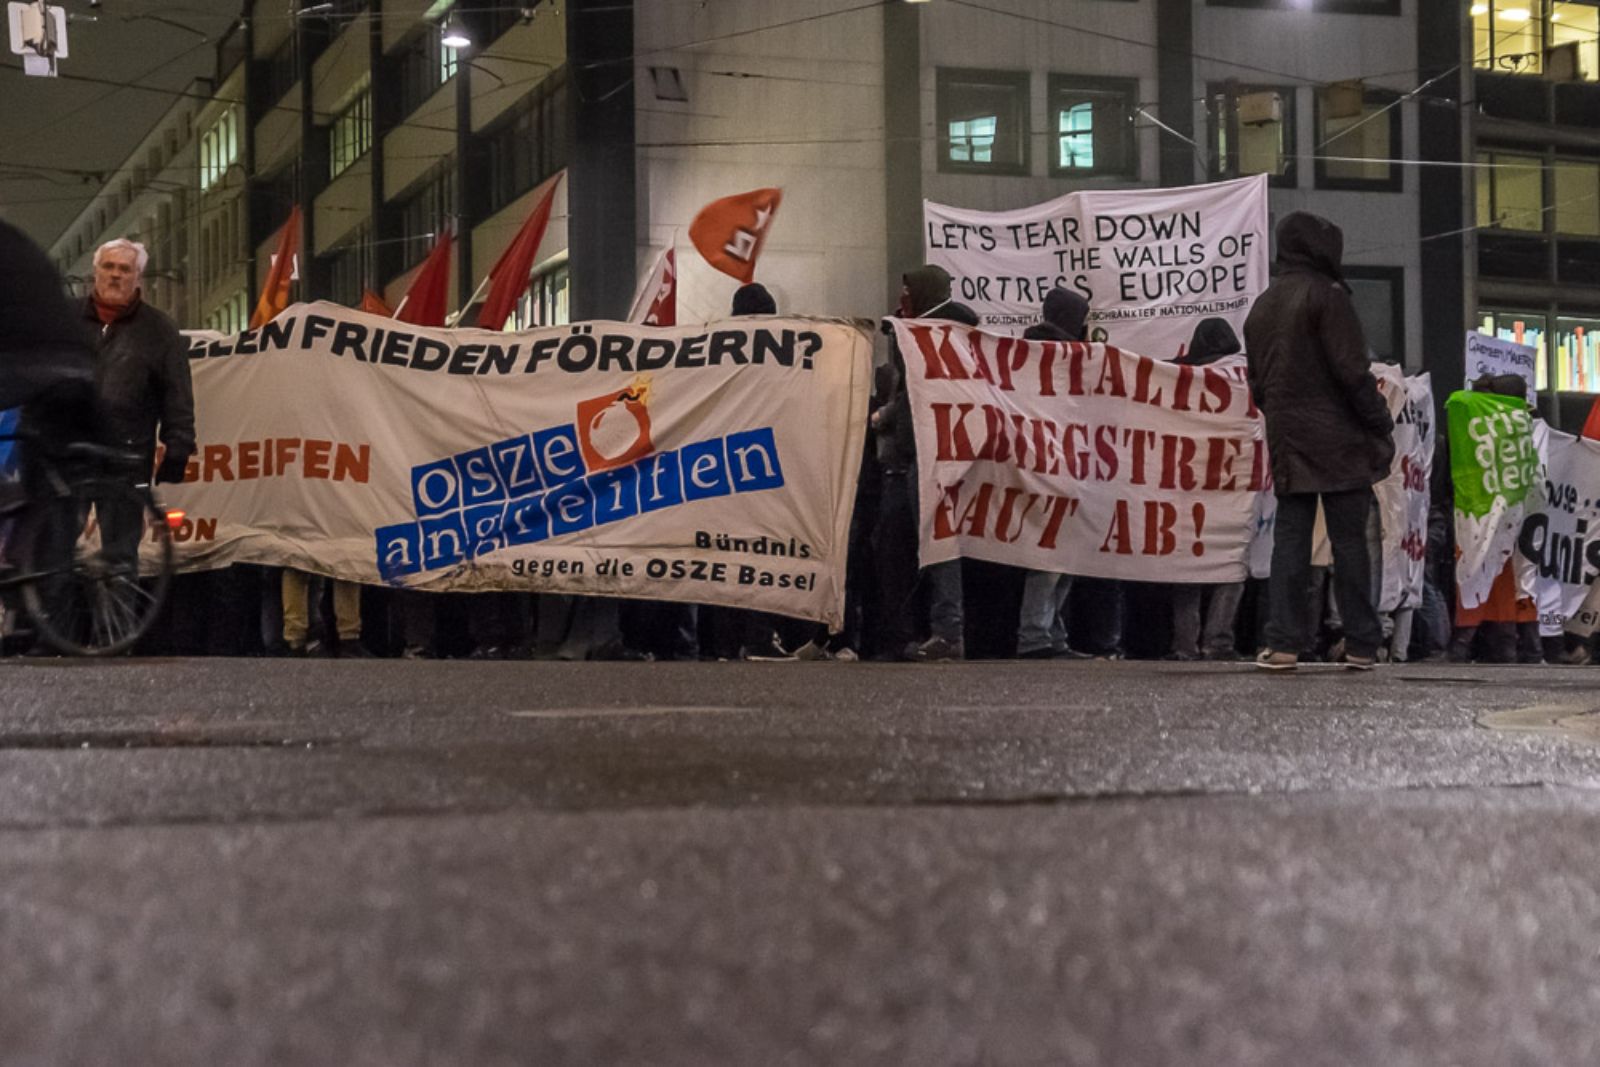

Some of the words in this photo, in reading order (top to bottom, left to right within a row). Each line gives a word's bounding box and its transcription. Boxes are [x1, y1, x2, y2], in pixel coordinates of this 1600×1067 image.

[928, 221, 996, 252] LET'S
[1007, 216, 1081, 250] TEAR
[1095, 211, 1201, 242] DOWN
[1054, 247, 1101, 272] THE
[1114, 243, 1205, 269] WALLS
[1218, 232, 1254, 258] OF
[950, 275, 1093, 302] ORTRES
[1119, 263, 1248, 301] EUROPE
[985, 313, 1043, 325] SOLIDARITÄ
[1089, 306, 1156, 321] SCHRÄNKTER
[301, 314, 520, 375] FRIEDEN
[524, 325, 823, 374] FÖRDERN?
[417, 434, 577, 509] osze
[385, 441, 778, 566] angreifen
[695, 531, 811, 560] Bündnis
[1100, 499, 1206, 557] AB!
[511, 558, 586, 578] gegen
[596, 557, 635, 577] die
[646, 558, 727, 583] OSZE
[738, 565, 816, 592] Basel
